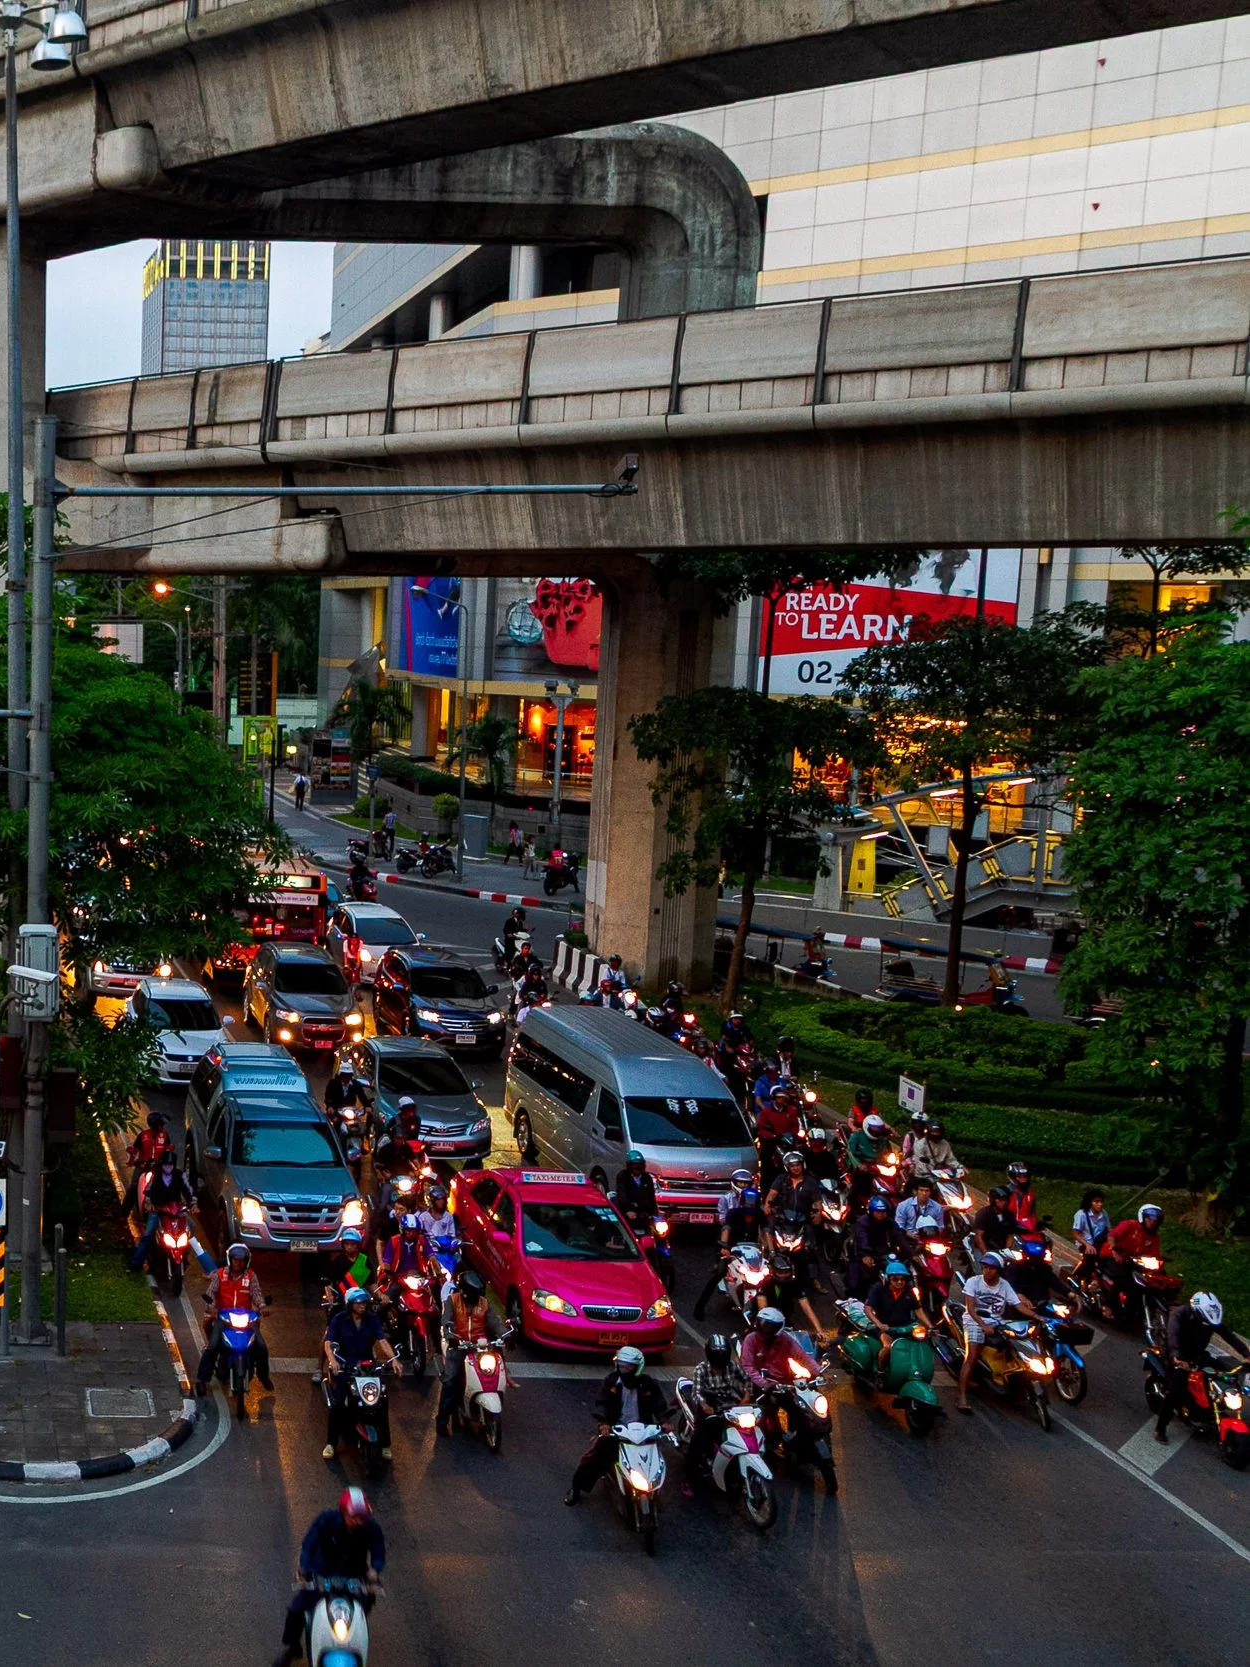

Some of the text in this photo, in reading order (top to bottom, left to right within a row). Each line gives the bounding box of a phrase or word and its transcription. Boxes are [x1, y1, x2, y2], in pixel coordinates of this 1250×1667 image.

[785, 593, 860, 611] READY
[775, 612, 913, 641] TO LEARN
